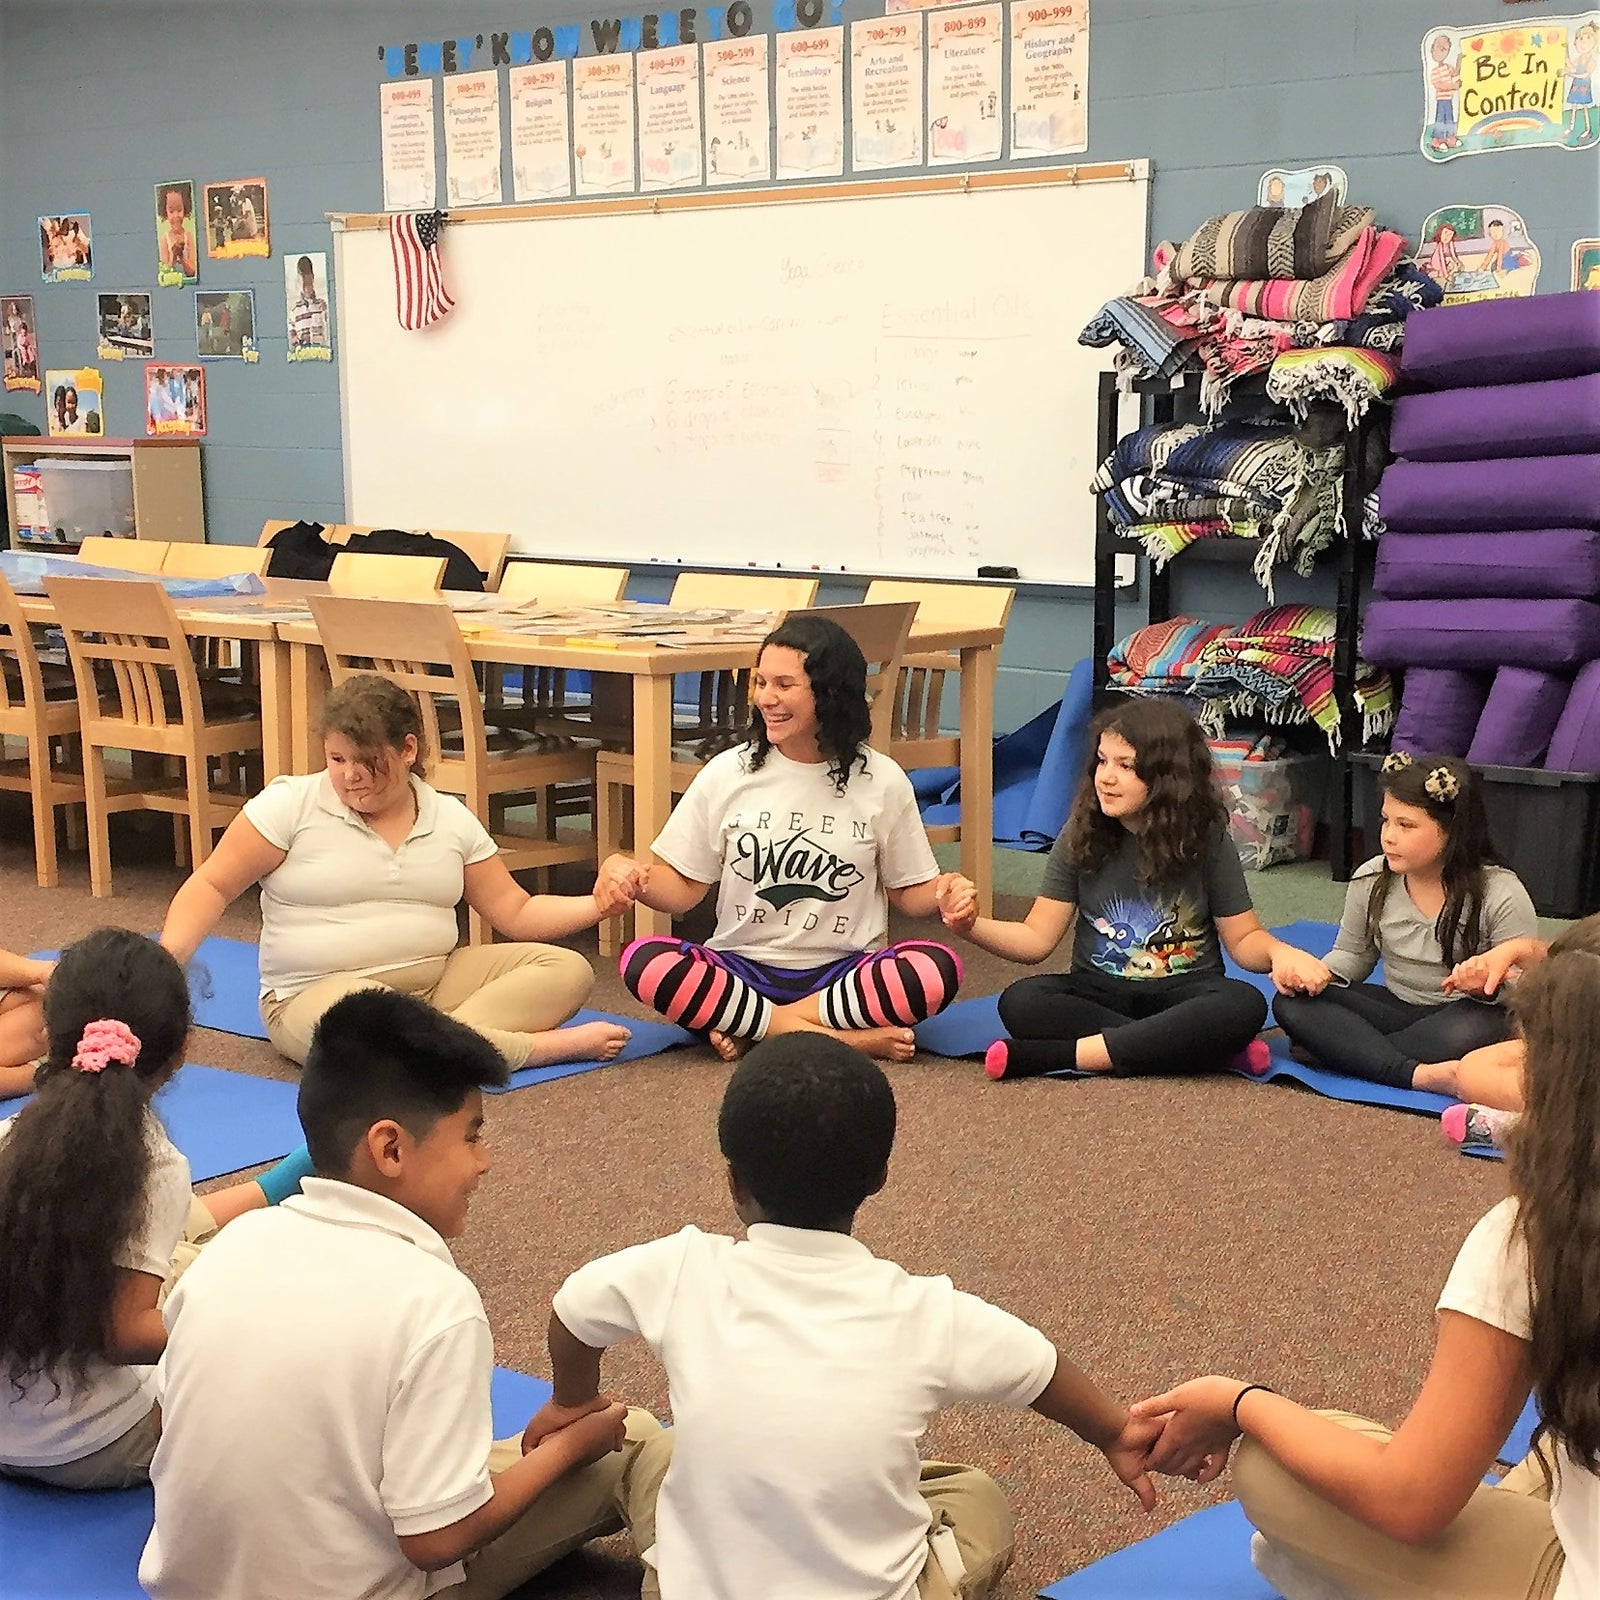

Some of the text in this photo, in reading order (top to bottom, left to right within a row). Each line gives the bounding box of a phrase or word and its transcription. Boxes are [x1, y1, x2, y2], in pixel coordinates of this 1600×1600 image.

[1027, 5, 1074, 23] 900-999
[944, 16, 987, 33] 800-899
[491, 25, 580, 66] KNOW
[591, 9, 697, 55] WHERE
[705, 0, 753, 40] TO
[866, 25, 907, 41] 700-799
[790, 38, 829, 53] 600-699
[1024, 34, 1076, 51] History and
[869, 53, 904, 66] Arts and
[944, 46, 986, 59] Literature
[1025, 47, 1073, 61] Geography
[787, 66, 832, 79] Technology
[864, 65, 908, 77] Recreation
[1475, 52, 1548, 82] Be In
[721, 75, 751, 86] Science
[579, 90, 628, 101] Social Sciences
[650, 83, 687, 96] Language
[1463, 79, 1558, 117] Control!
[737, 828, 856, 890] Wave
[735, 904, 850, 934] PRIDE
